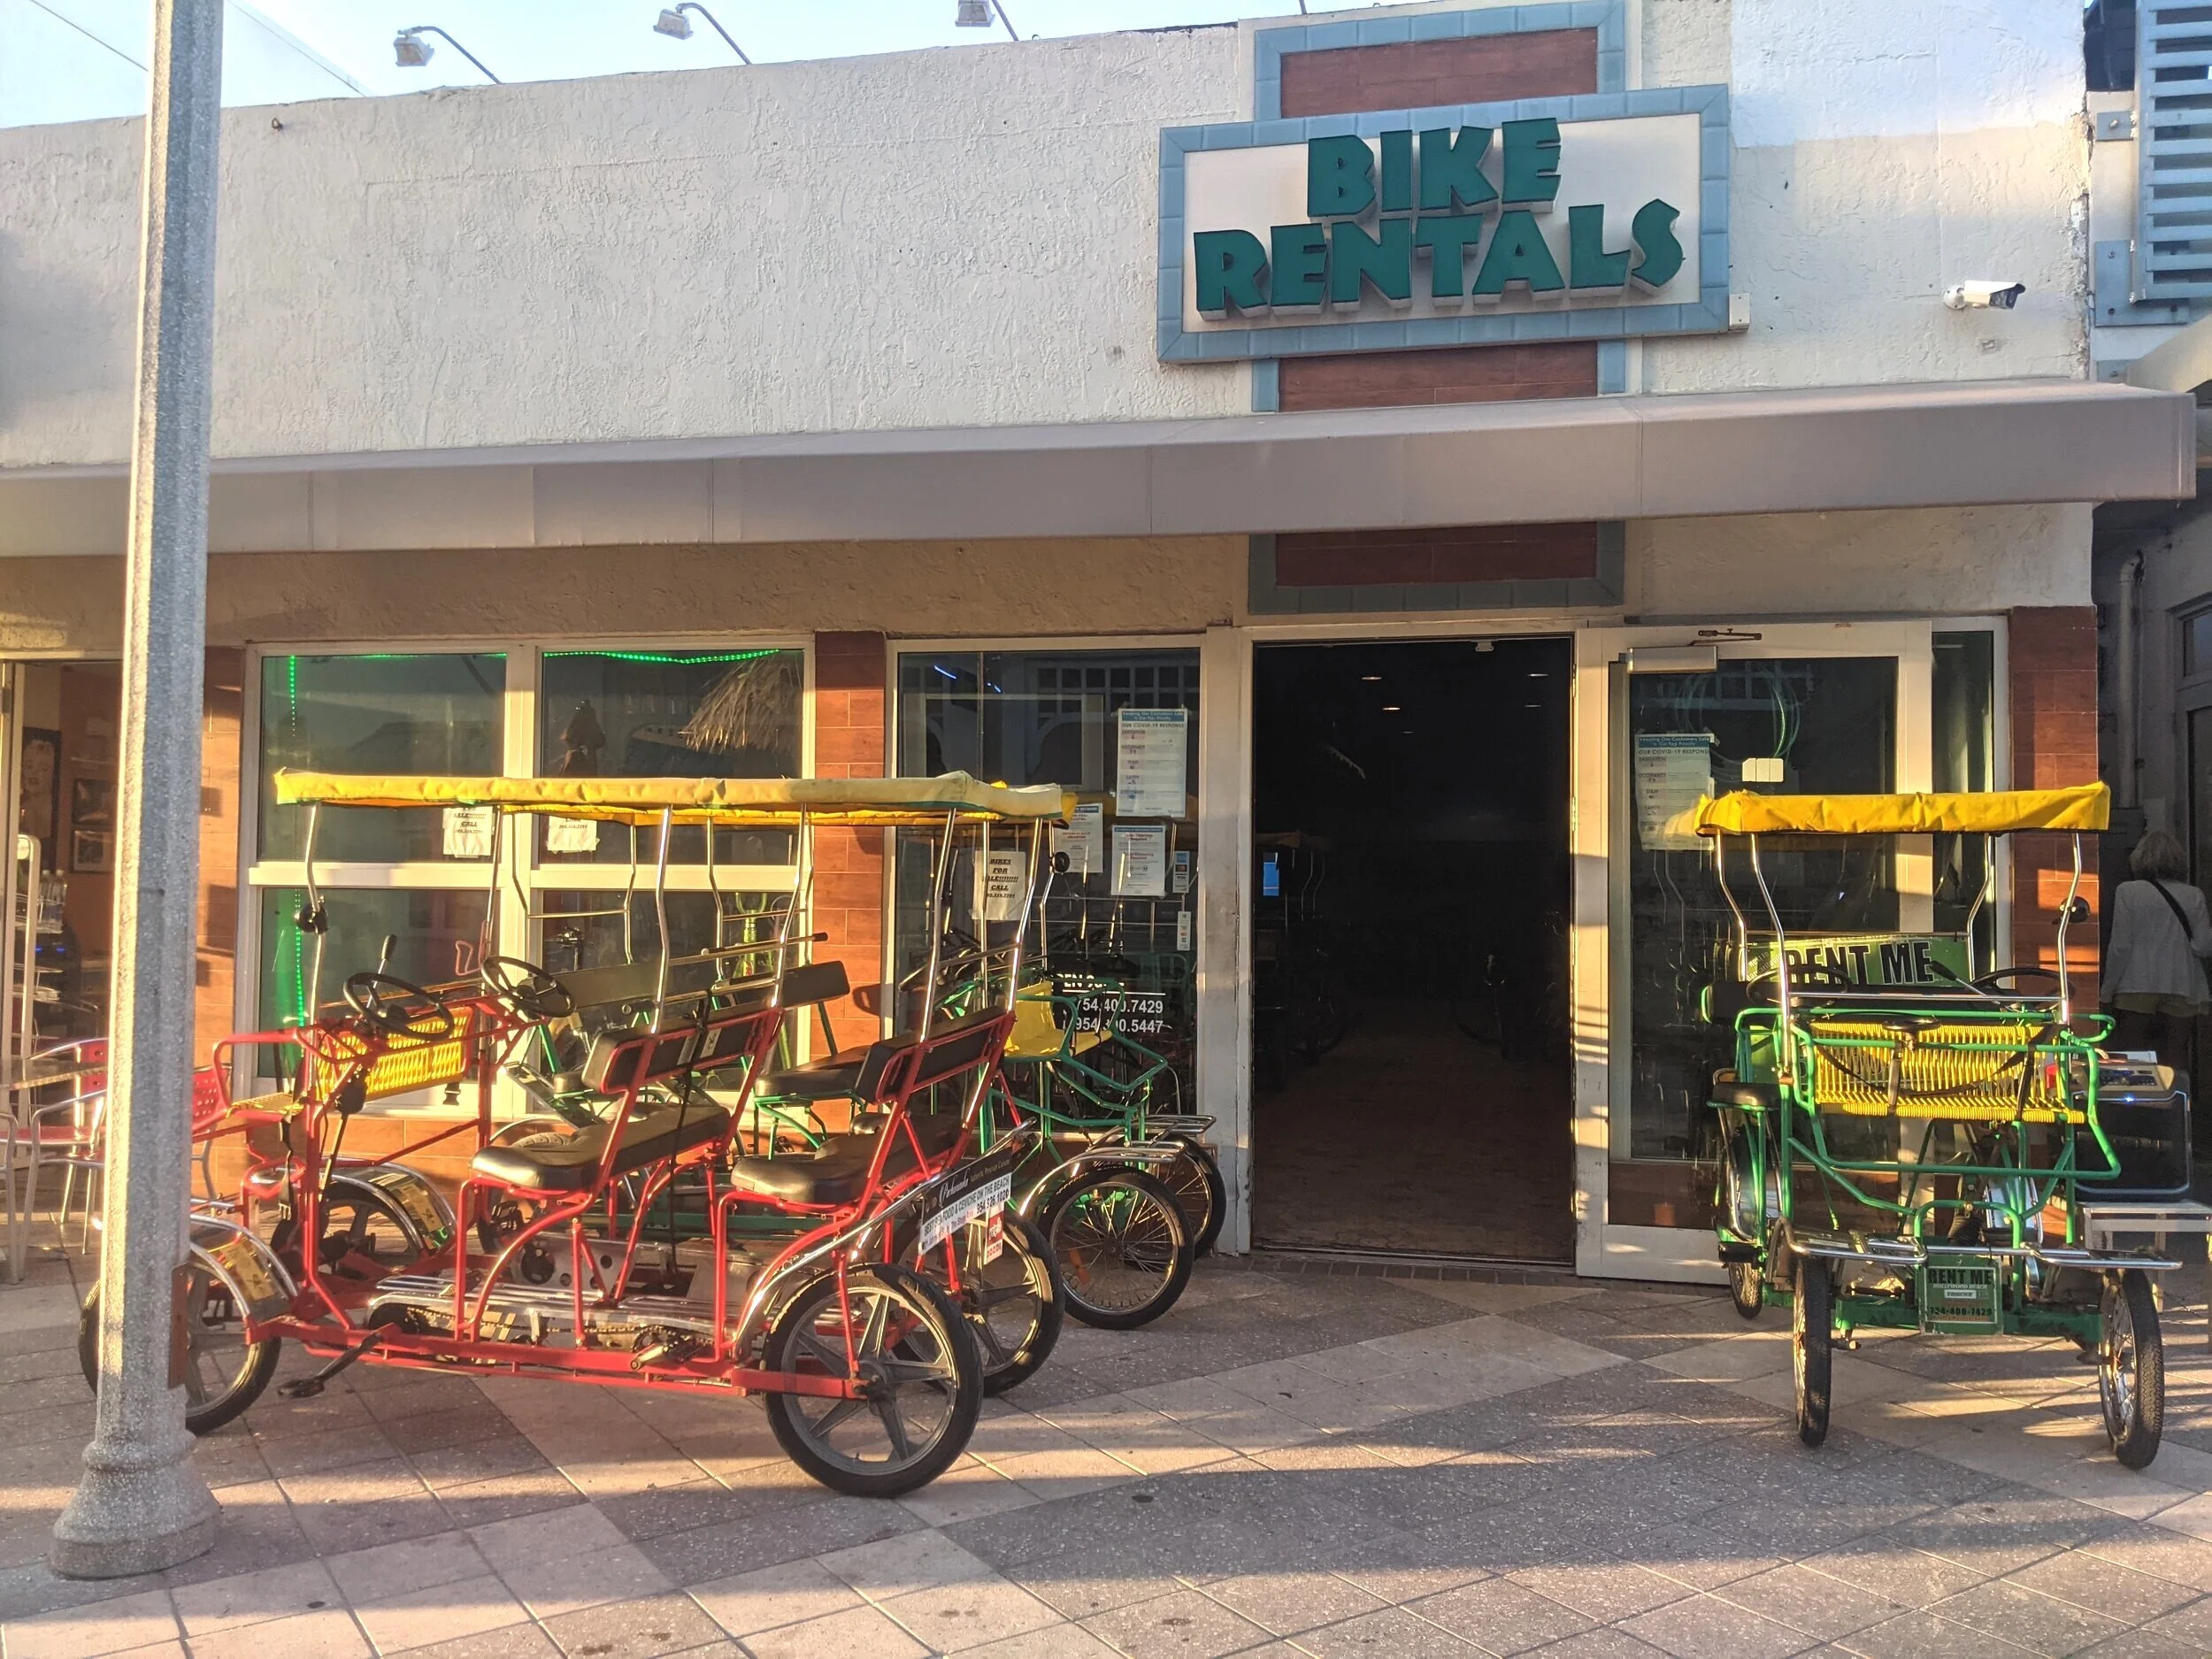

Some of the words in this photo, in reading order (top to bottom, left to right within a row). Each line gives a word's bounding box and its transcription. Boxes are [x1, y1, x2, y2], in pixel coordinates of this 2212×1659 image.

[1307, 118, 1561, 219] BIKE
[1194, 199, 1683, 317] RENTALS
[1786, 943, 1870, 986] RENT
[1878, 941, 1935, 984] ME
[958, 1195, 977, 1213] CEVICHE
[994, 1177, 1010, 1192] BEACH
[1928, 1269, 1966, 1284] RENT
[1970, 1269, 1993, 1285] ME
